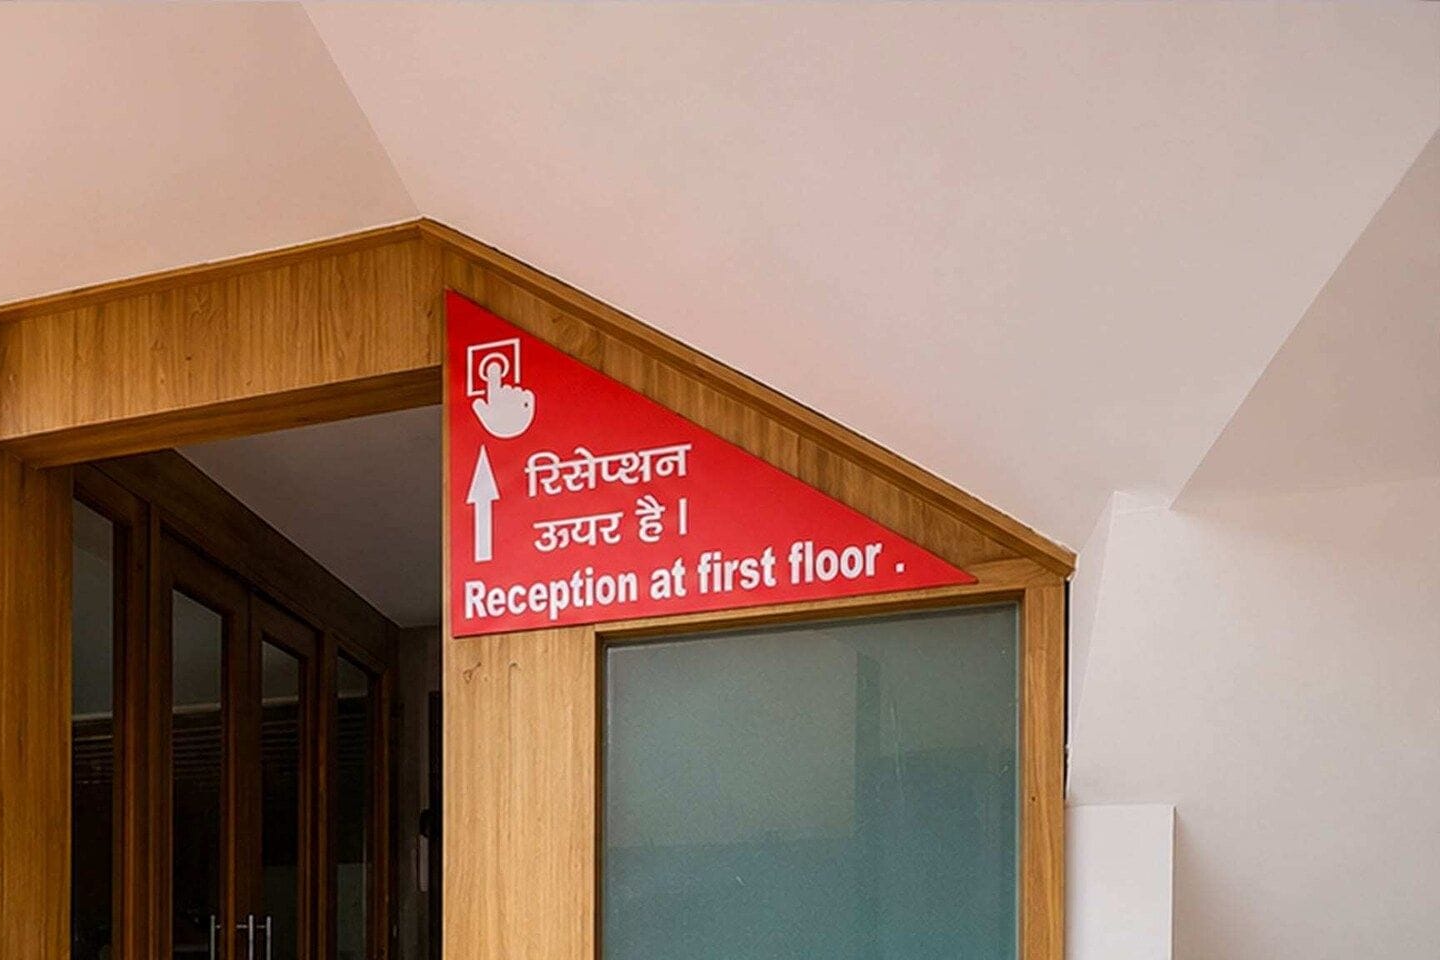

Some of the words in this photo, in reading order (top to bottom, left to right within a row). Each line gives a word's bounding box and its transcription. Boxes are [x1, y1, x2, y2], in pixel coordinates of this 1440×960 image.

[524, 443, 692, 498] रिसेप्शन
[464, 567, 639, 621] Reception
[649, 557, 686, 598] at
[697, 549, 777, 594] first
[788, 541, 882, 585] floor
